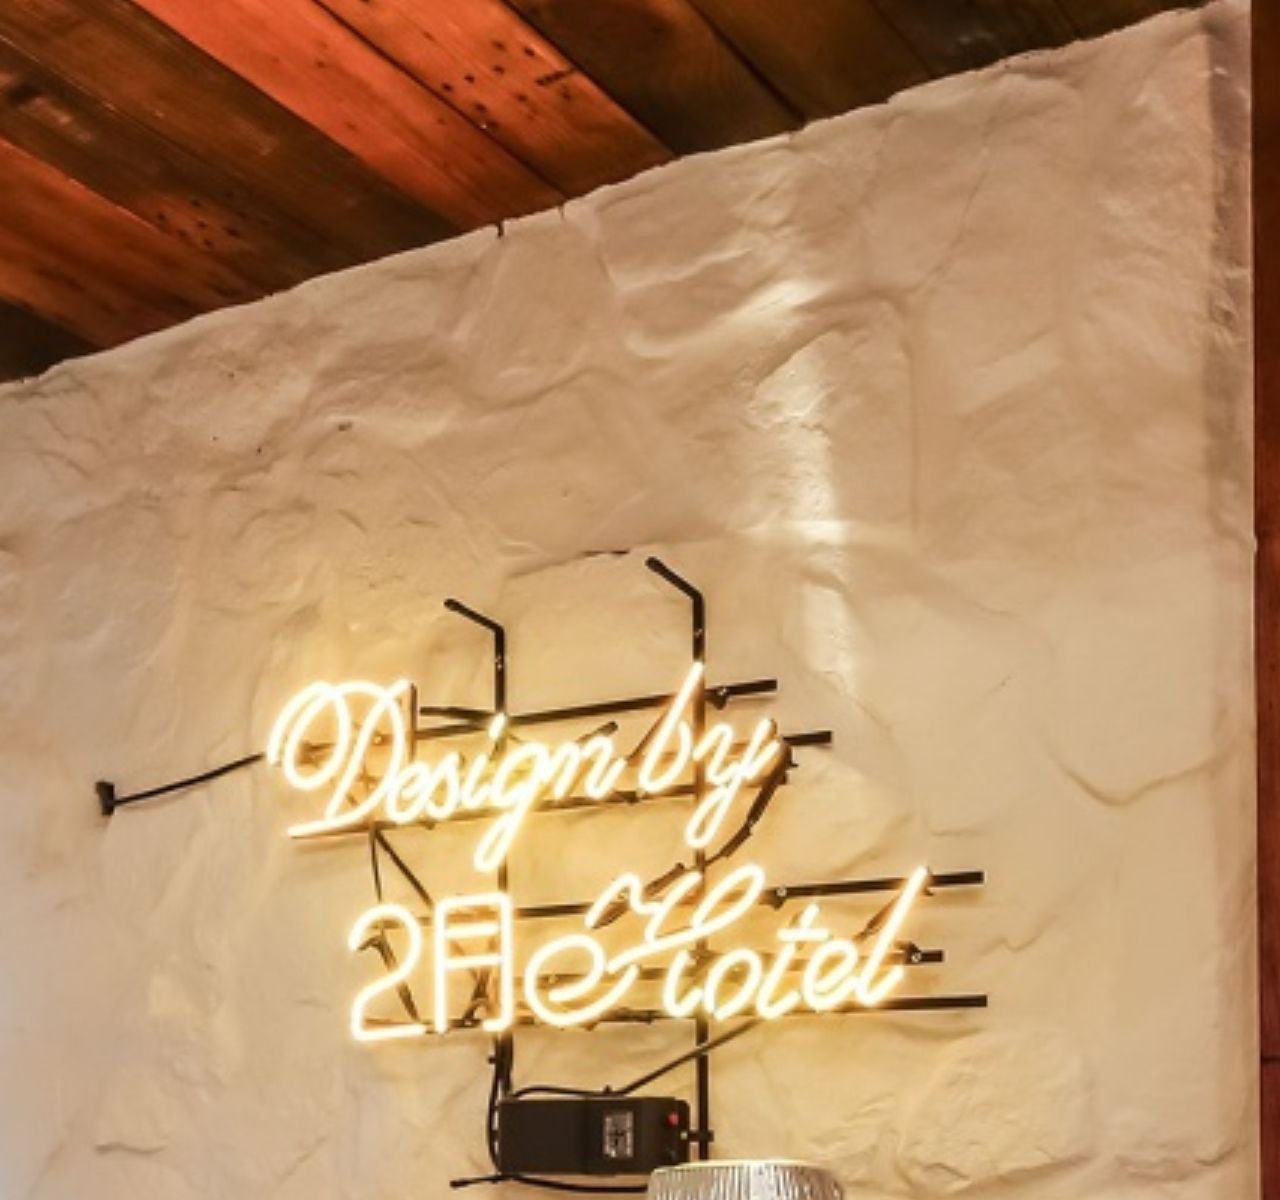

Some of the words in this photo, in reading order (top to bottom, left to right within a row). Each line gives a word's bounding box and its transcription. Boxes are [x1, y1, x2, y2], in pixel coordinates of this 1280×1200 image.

[265, 676, 634, 874] Design
[638, 659, 785, 849] by
[523, 862, 934, 1028] Hotel
